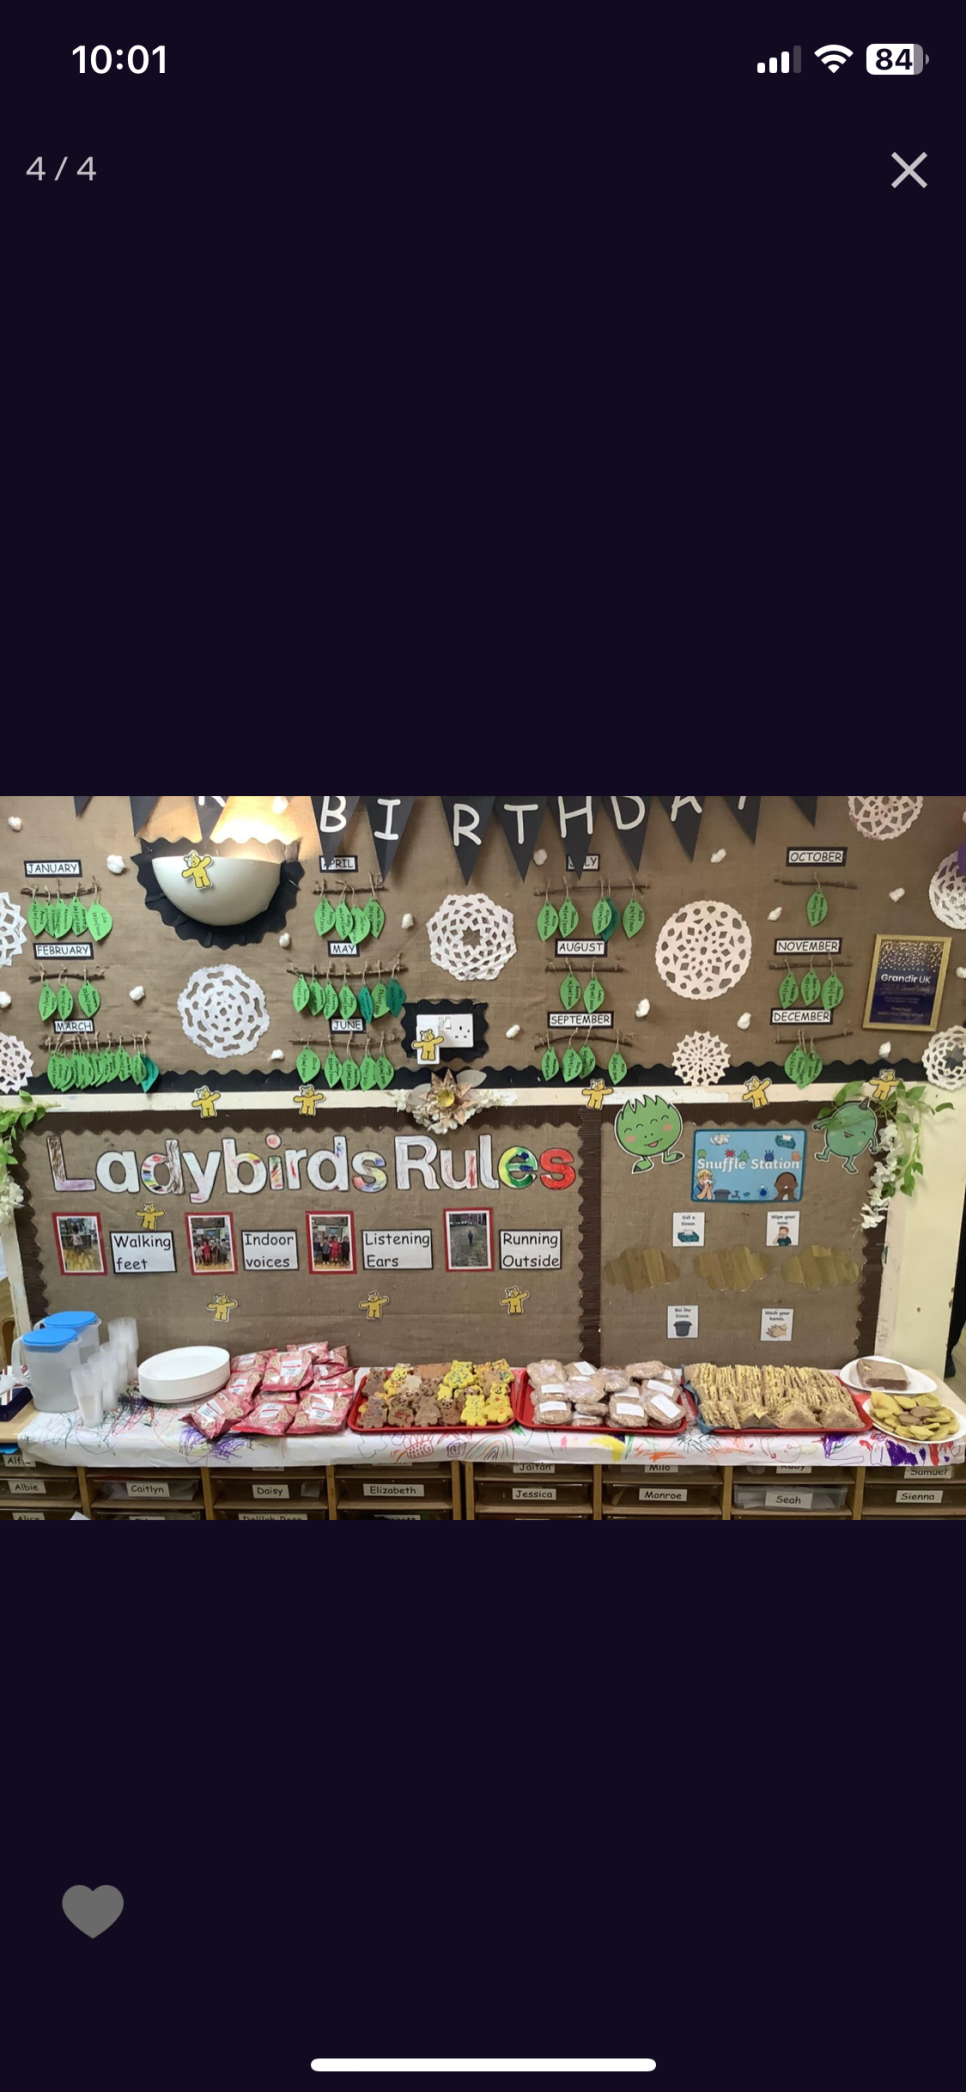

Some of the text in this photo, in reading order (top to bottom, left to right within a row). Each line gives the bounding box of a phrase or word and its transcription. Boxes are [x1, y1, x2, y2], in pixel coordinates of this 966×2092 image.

[790, 851, 842, 863] OCTOBER
[28, 863, 78, 874] JANUARY
[37, 945, 89, 955] FEBRUARY
[332, 944, 356, 955] MAY
[559, 942, 604, 952] AUGUST
[778, 941, 838, 952] NOVEMBER
[880, 973, 931, 984] Grandir UK
[551, 1014, 610, 1024] SEPTEMBER
[773, 1010, 830, 1022] DECEMBER
[57, 1021, 92, 1031] MARCH
[332, 1020, 362, 1031] JUNE
[46, 1134, 576, 1203] Ladybirds Rules
[697, 1158, 800, 1172] Snuffle Station
[114, 1235, 171, 1251] Walking
[244, 1233, 294, 1246] Indoor
[365, 1233, 431, 1247] Listening
[503, 1233, 558, 1247] Running
[116, 1256, 148, 1270] feet
[246, 1255, 290, 1268] voices
[366, 1254, 399, 1268] Ears
[502, 1254, 560, 1268] Outside
[14, 1483, 40, 1491] Albie
[130, 1484, 165, 1496] Caitlyn
[256, 1487, 284, 1497] Daisy
[369, 1485, 417, 1495] Elizabeth
[515, 1489, 553, 1499] Jessica
[644, 1491, 682, 1500] Monroe
[900, 1492, 935, 1501] Sienna
[775, 1495, 802, 1505] Seah
